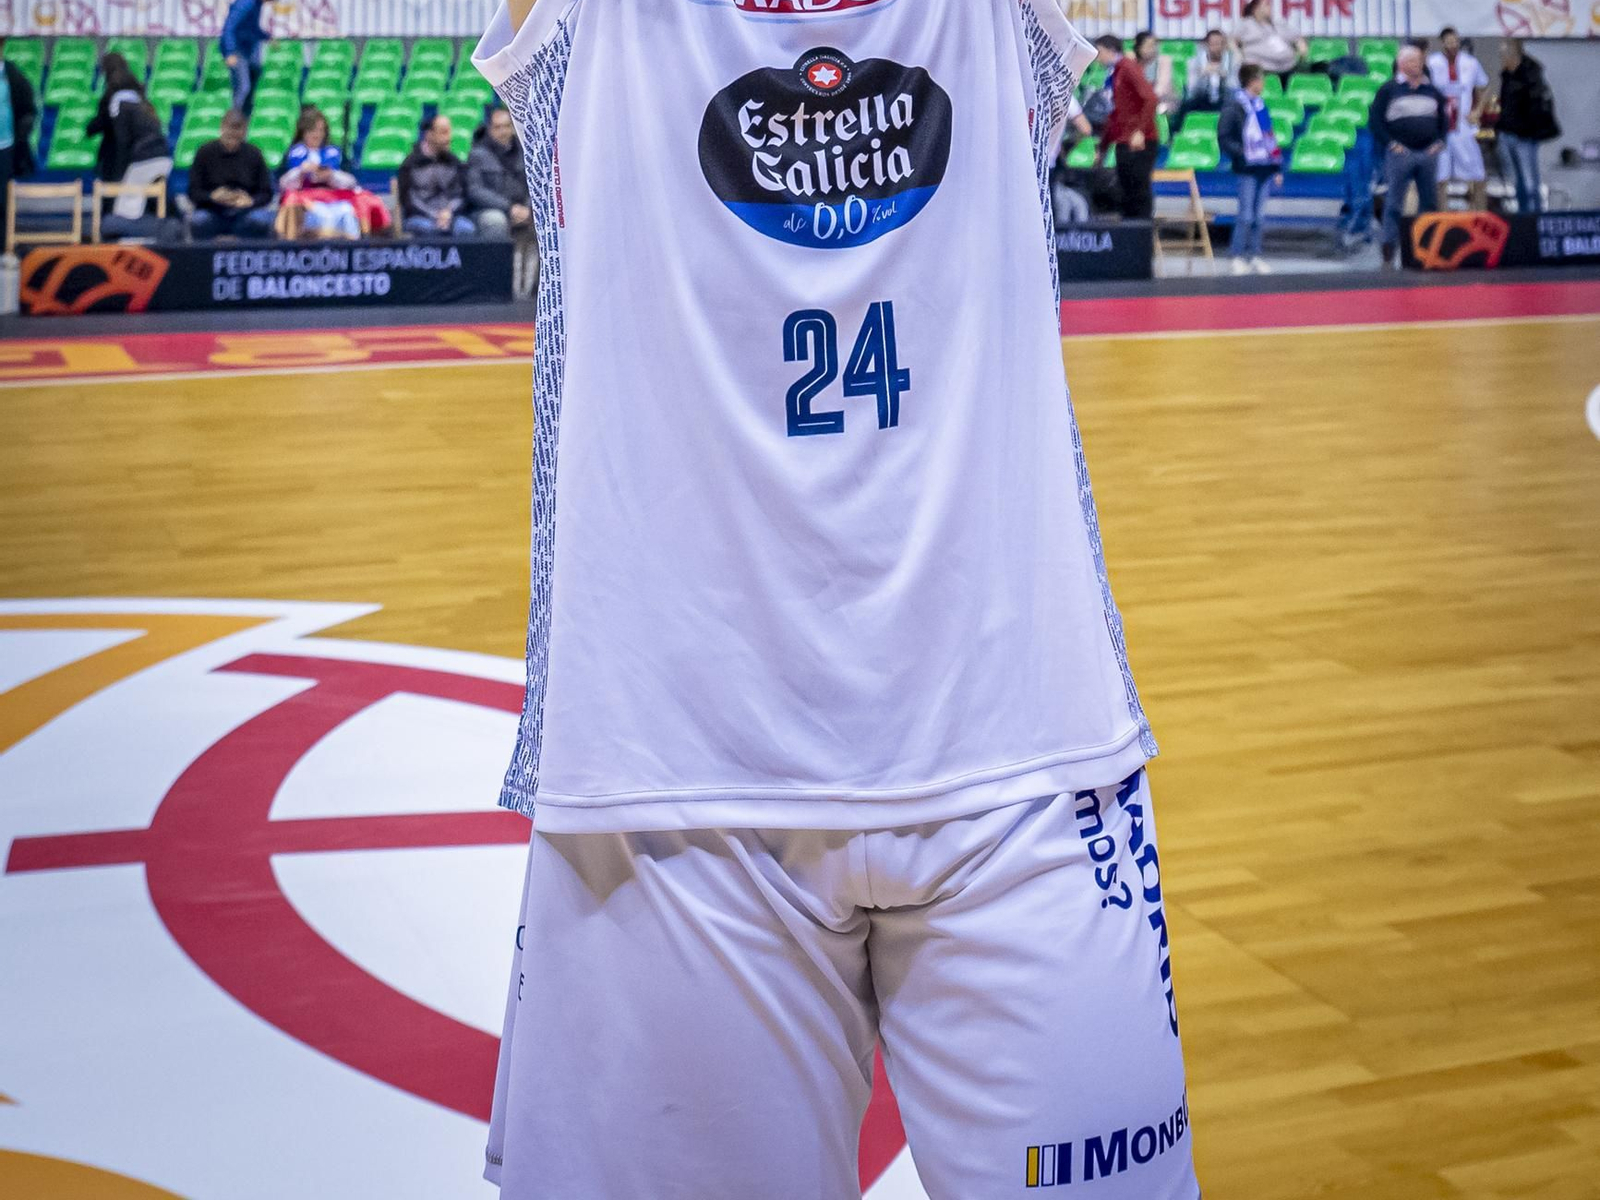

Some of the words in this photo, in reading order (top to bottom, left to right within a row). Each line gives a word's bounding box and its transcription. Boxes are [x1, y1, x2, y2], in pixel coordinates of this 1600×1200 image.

[737, 93, 915, 148] Estrella
[752, 138, 915, 197] Galicia
[813, 194, 868, 240] 0,0
[213, 248, 349, 274] FEDERACIÓN
[353, 246, 462, 271] ESPAÑOLA
[213, 276, 243, 300] DE
[247, 272, 391, 298] BALONCESTO
[783, 300, 910, 437] 24
